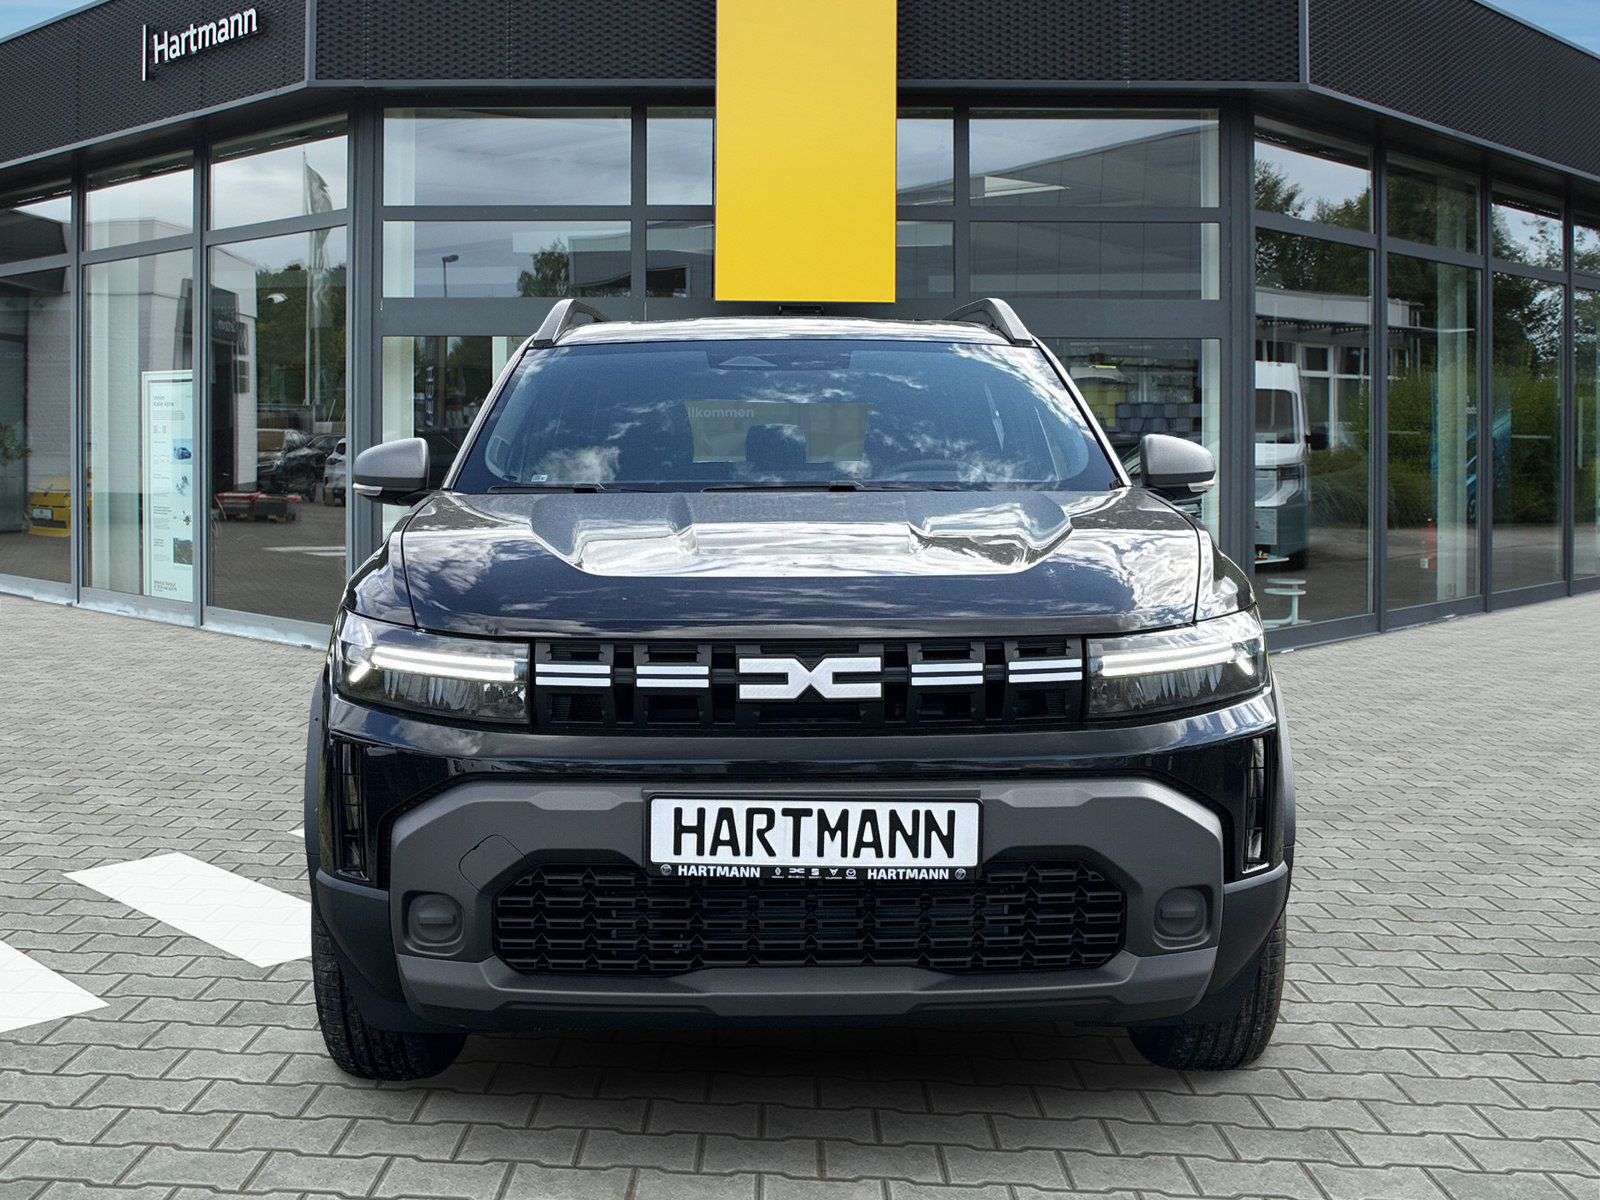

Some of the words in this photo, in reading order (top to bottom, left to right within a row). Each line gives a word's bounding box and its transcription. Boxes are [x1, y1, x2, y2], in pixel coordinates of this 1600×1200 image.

[153, 8, 258, 65] Hartmann
[673, 806, 956, 859] HARTMANN
[677, 864, 761, 879] HARTMANN
[867, 867, 950, 881] HARTMANN
